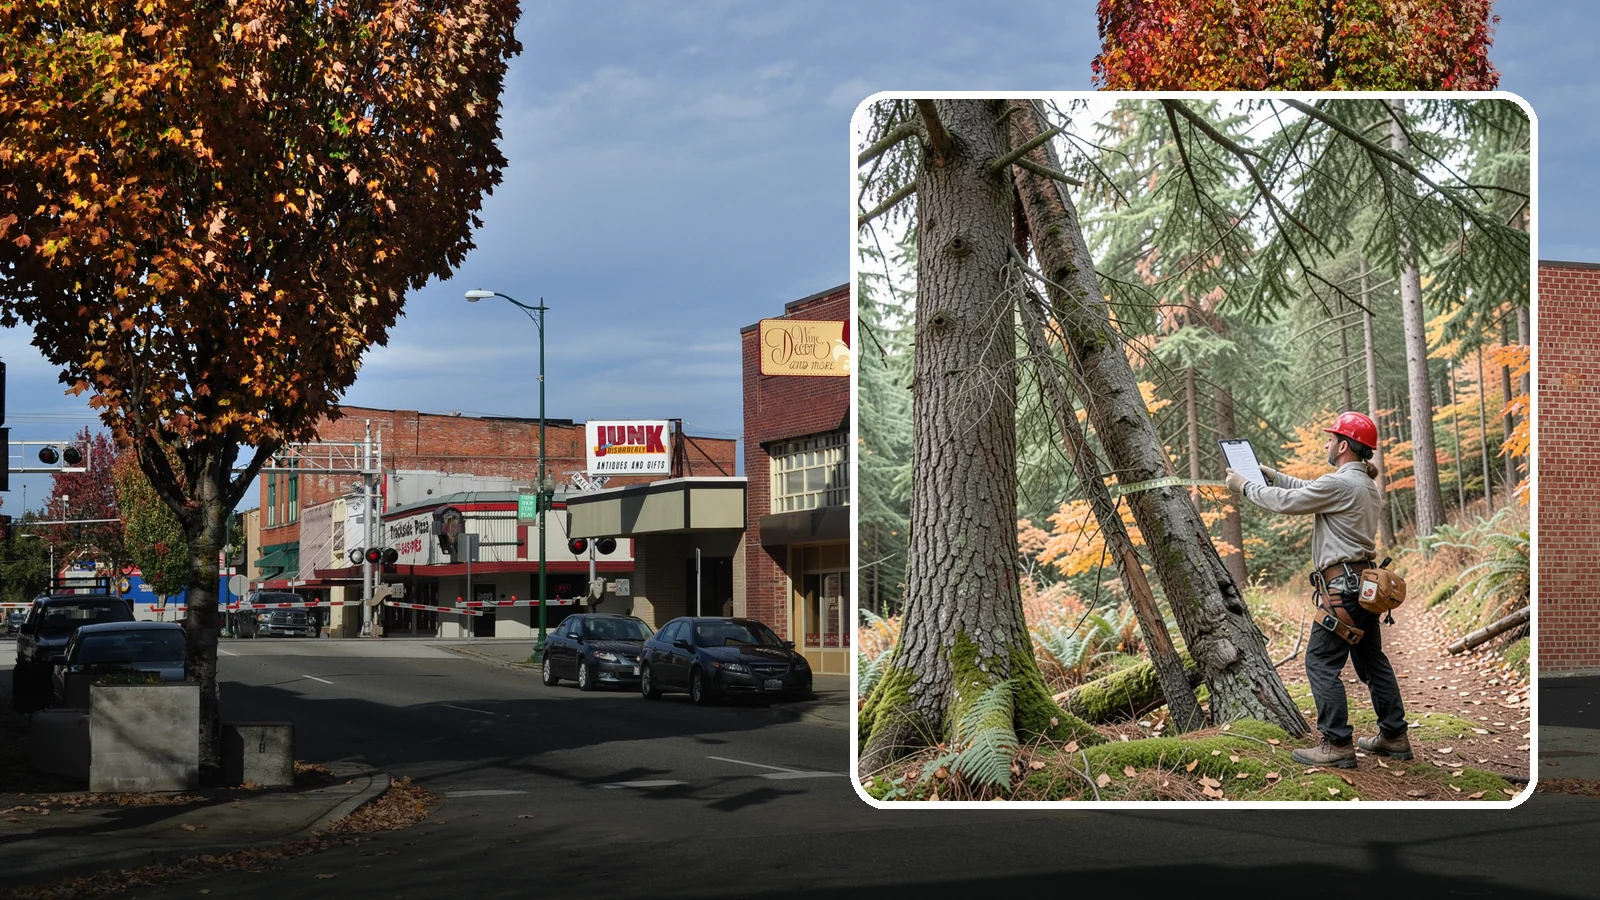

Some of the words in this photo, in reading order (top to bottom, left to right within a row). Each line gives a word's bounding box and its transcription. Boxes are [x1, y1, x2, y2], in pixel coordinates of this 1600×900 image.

[595, 425, 664, 457] JUNK
[607, 446, 646, 454] DISORDERLY
[596, 461, 628, 470] ANTIQUES
[631, 461, 644, 470] AND
[647, 460, 665, 470] GIFTS
[414, 520, 428, 534] Pizza
